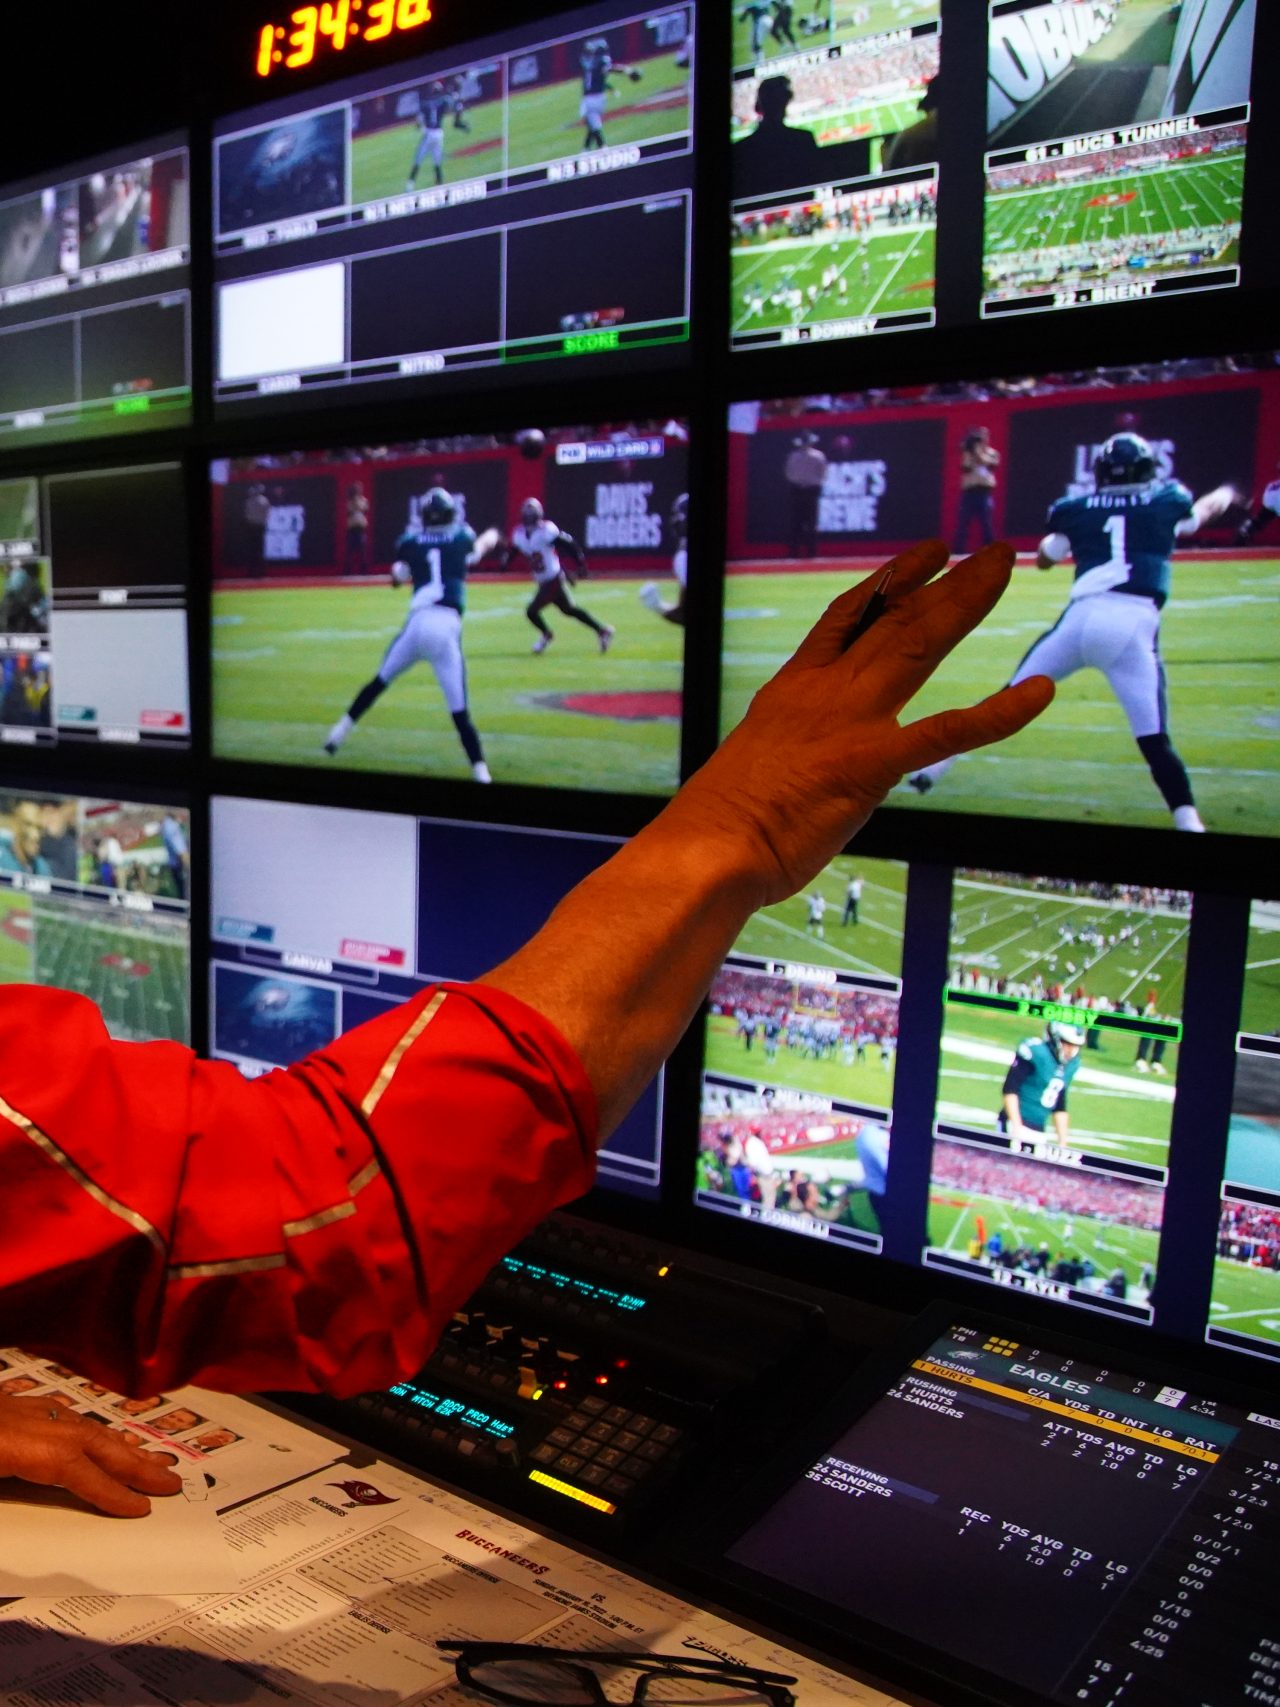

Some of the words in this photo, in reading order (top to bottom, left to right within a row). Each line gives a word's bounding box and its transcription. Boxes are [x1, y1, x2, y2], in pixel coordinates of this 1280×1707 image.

[1063, 131, 1115, 157] BUCS
[1119, 117, 1200, 146] TUNNEL
[577, 146, 641, 175] STUDIO
[1091, 281, 1157, 303] BRENT
[563, 330, 620, 354] SCORE
[1103, 515, 1133, 580] 1
[426, 548, 445, 595] 1
[280, 951, 333, 975] CANVAS
[1042, 1005, 1099, 1027] GIBBY
[1040, 1078, 1065, 1109] 8
[1033, 1142, 1084, 1166] BUZZ
[1023, 1278, 1070, 1301] KYLE
[952, 1333, 966, 1342] TB
[958, 1326, 978, 1337] PHI
[930, 1365, 973, 1384] HURTS
[1009, 1363, 1091, 1395] EAGLES
[926, 1356, 976, 1376] PASSING
[1028, 1387, 1050, 1400] C/A
[1064, 1399, 1091, 1412] YDS
[1097, 1408, 1116, 1420] TD
[1121, 1417, 1148, 1429] INT
[1152, 1426, 1173, 1438] LG
[1184, 1436, 1217, 1451] RAT
[1190, 1405, 1216, 1416] 4:34
[465, 1409, 490, 1423] PRCO
[490, 1419, 514, 1434] Hdst
[906, 1376, 958, 1398] RUSHING
[1043, 1421, 1072, 1435] ATT
[1076, 1430, 1103, 1445] YDS
[1104, 1441, 1136, 1456] AVG
[1144, 1452, 1164, 1465] TD
[1176, 1464, 1199, 1477] LG
[910, 1386, 954, 1406] HURTS
[1104, 1450, 1125, 1462] 3.0
[886, 1389, 903, 1399] 26
[903, 1394, 965, 1420] SANDERS
[1040, 1439, 1050, 1447] 2
[1072, 1450, 1082, 1458] 2
[1099, 1459, 1119, 1470] 1.0
[1136, 1471, 1146, 1479] 0
[1171, 1482, 1182, 1490] 7
[1263, 1460, 1279, 1470] 15
[308, 1496, 348, 1518] BUCCANEERS
[825, 1456, 889, 1485] RECEIVING
[960, 1506, 992, 1523] REC
[1001, 1520, 1030, 1538] YDS
[1030, 1534, 1064, 1550] AVG
[1071, 1547, 1093, 1561] TD
[1105, 1560, 1129, 1574] LG
[1235, 1506, 1245, 1514] 8
[805, 1470, 822, 1482] 35
[822, 1477, 866, 1498] SCOTT
[1025, 1553, 1045, 1566] 1.0
[1062, 1568, 1073, 1577] 0
[812, 1462, 829, 1474] 26
[830, 1469, 894, 1498] SANDERS
[1003, 1534, 1012, 1542] 6
[1030, 1544, 1052, 1557] 6.0
[1070, 1559, 1080, 1567] 0
[1105, 1573, 1115, 1581] 6
[455, 1528, 551, 1576] BUCCANEERS
[1195, 1551, 1222, 1565] 0/2
[1187, 1563, 1213, 1577] 0/0
[1178, 1575, 1204, 1590] 0/0
[1177, 1591, 1188, 1599] 0
[1159, 1600, 1192, 1618] 1/15
[1152, 1614, 1179, 1629] 0/0
[1143, 1627, 1170, 1643] 0/0
[1130, 1640, 1165, 1658] 4:25
[1094, 1659, 1112, 1672] 15
[1087, 1674, 1099, 1684] 7
[1076, 1688, 1089, 1698] 8
